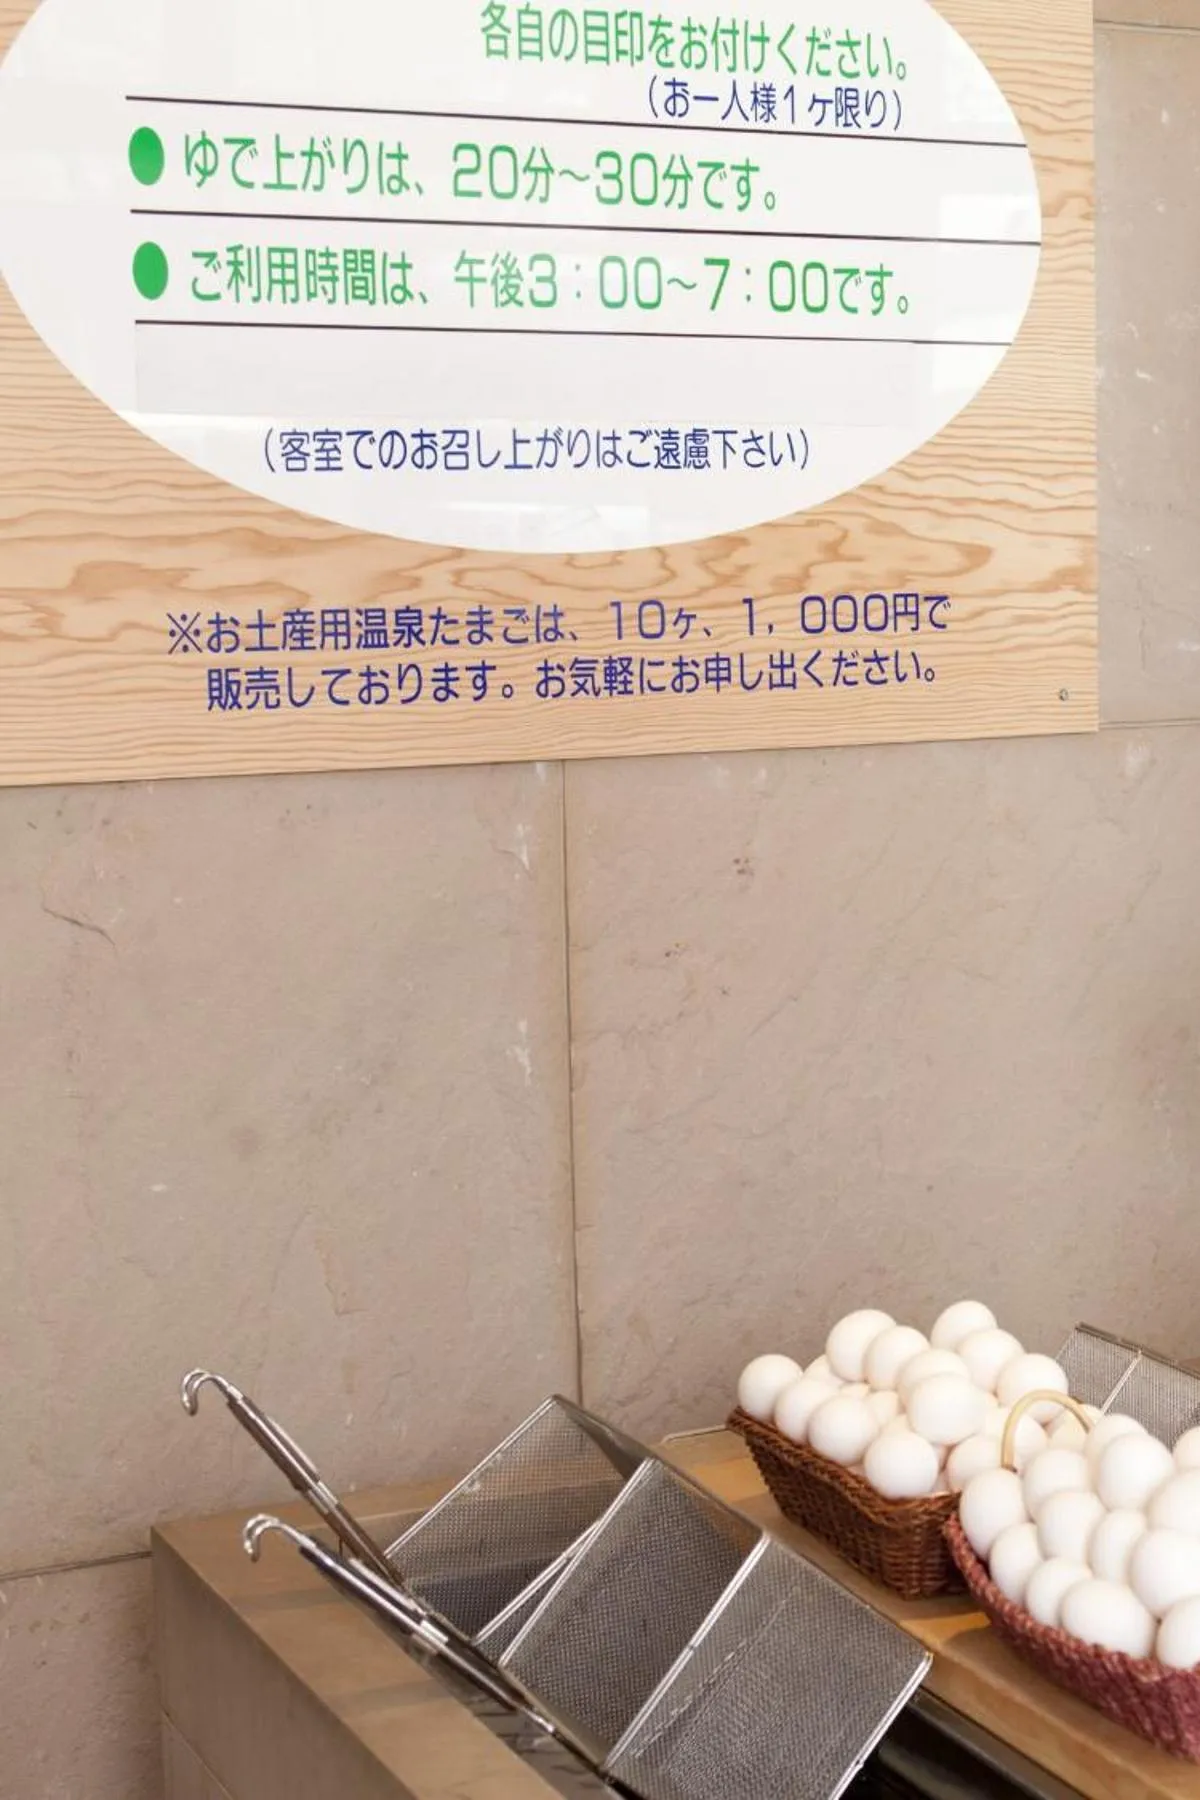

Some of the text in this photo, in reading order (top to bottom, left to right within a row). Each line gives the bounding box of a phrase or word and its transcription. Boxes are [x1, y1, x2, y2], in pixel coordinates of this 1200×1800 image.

[480, 0, 907, 80] 各自の目印をお付けください。
[206, 648, 936, 711] 販売しております。お気軽にお申し出ください。
